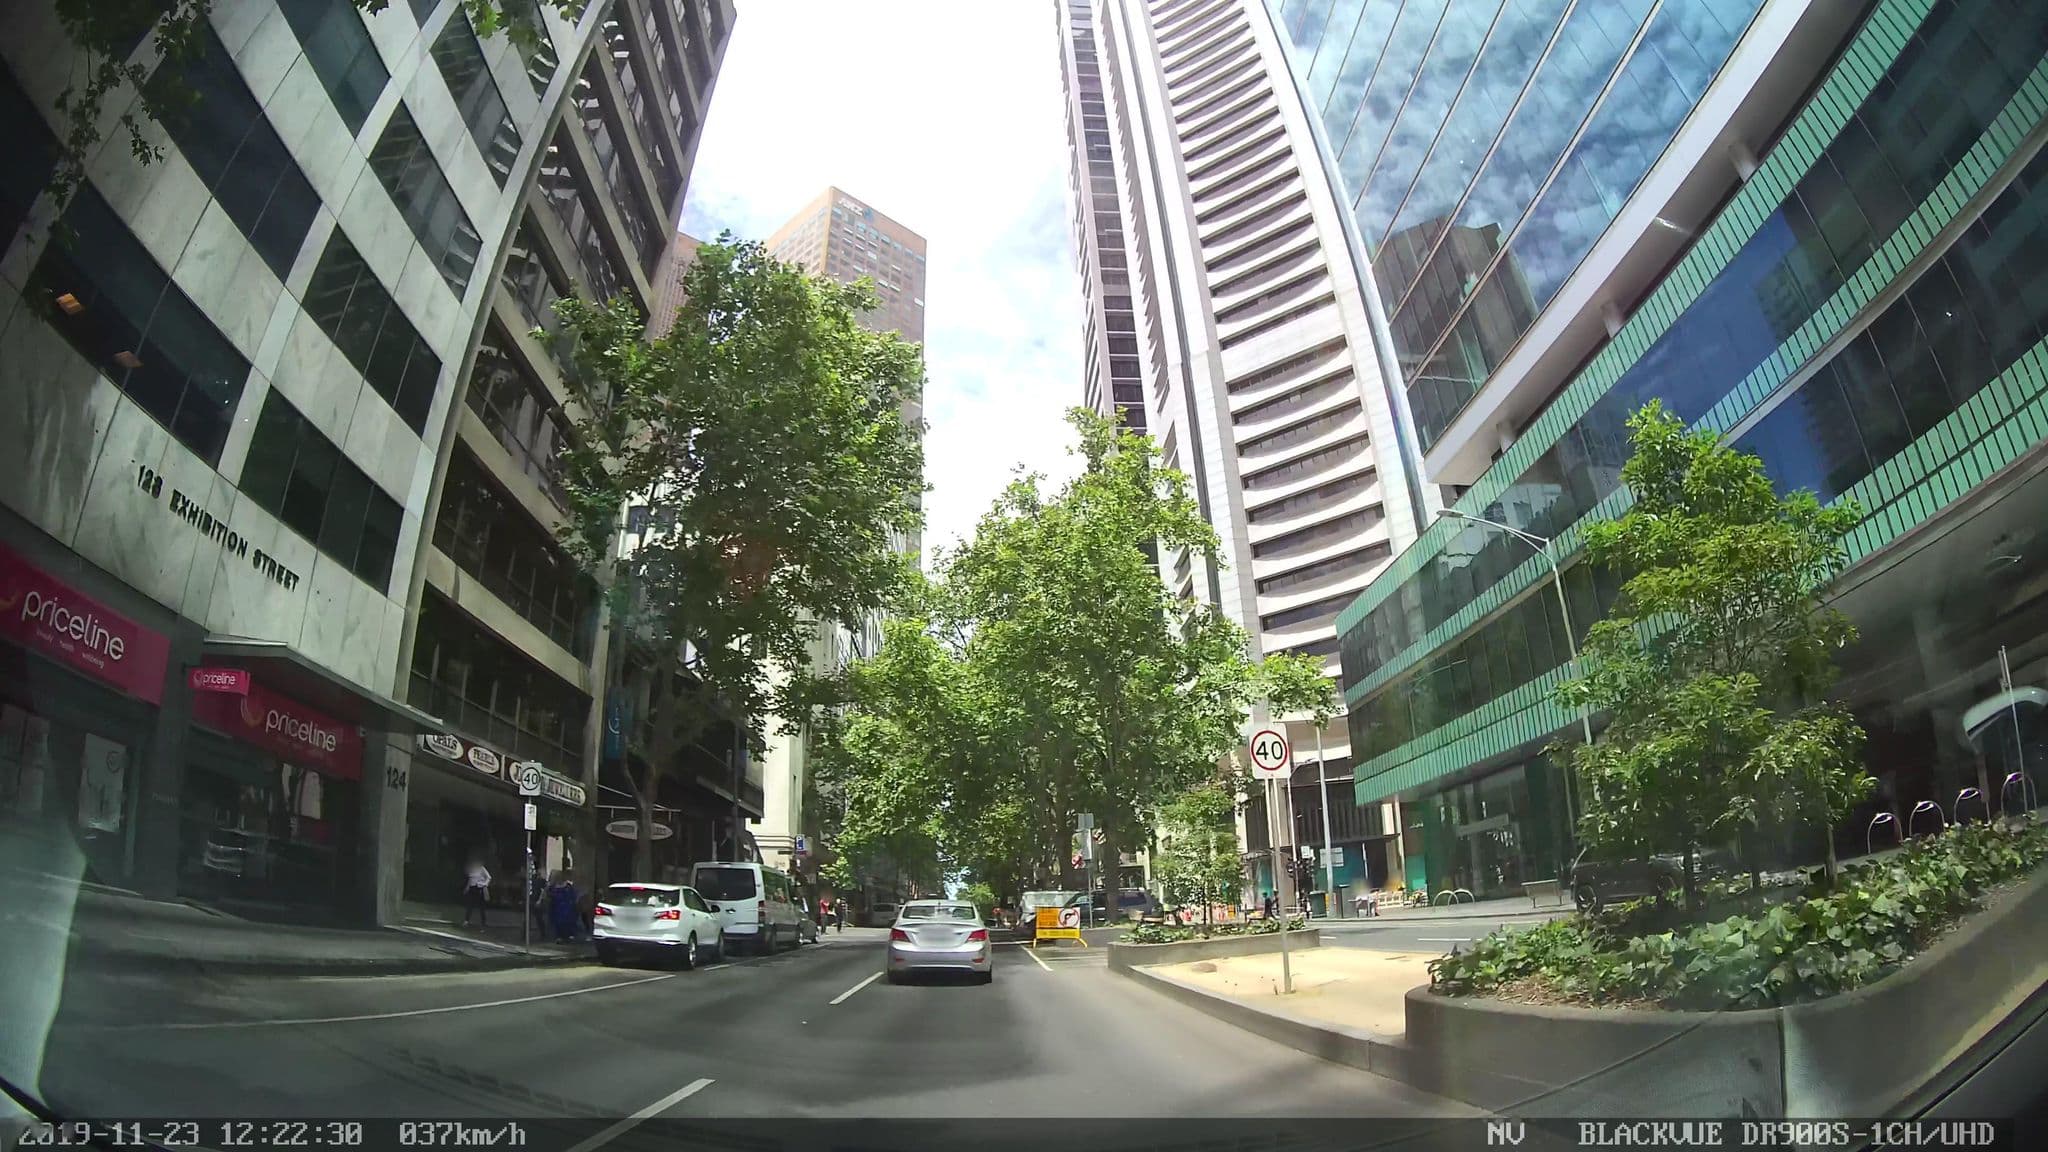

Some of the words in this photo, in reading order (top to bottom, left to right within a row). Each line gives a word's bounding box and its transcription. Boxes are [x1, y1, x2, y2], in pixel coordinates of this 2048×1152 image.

[169, 489, 248, 560] EXHIBITION
[252, 549, 300, 592] STREET
[22, 591, 125, 660] priceline
[203, 672, 236, 686] priceline
[265, 709, 337, 751] priceline
[1256, 741, 1283, 760] 40
[386, 766, 407, 792] 124
[523, 773, 538, 786] 40
